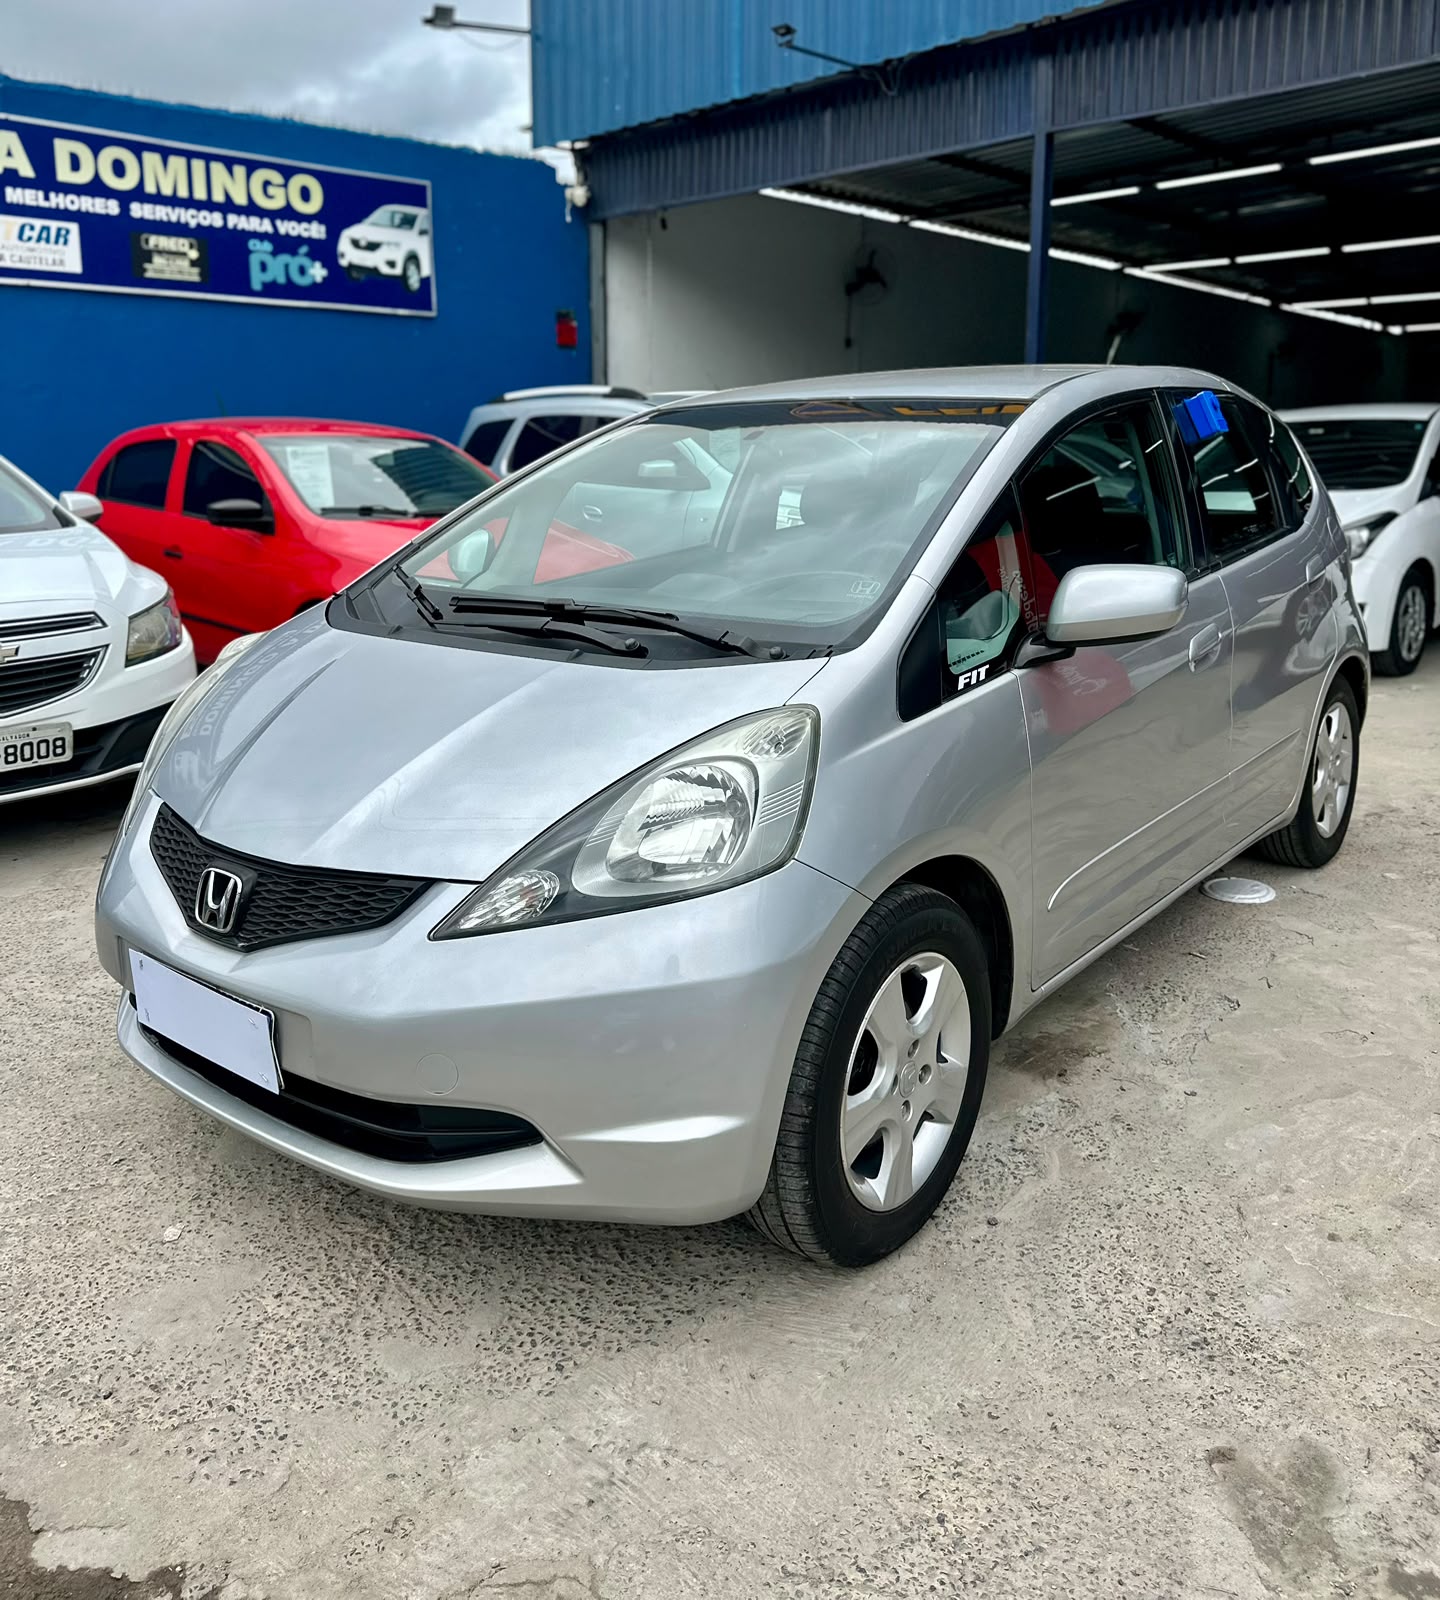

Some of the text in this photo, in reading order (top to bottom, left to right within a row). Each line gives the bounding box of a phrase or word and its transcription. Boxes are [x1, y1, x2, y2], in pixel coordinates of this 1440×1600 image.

[0, 129, 324, 215] A DOMINGO
[4, 185, 327, 240] MELHORES SERVIÇOS PARA VOCÊ!
[957, 664, 989, 691] FIT
